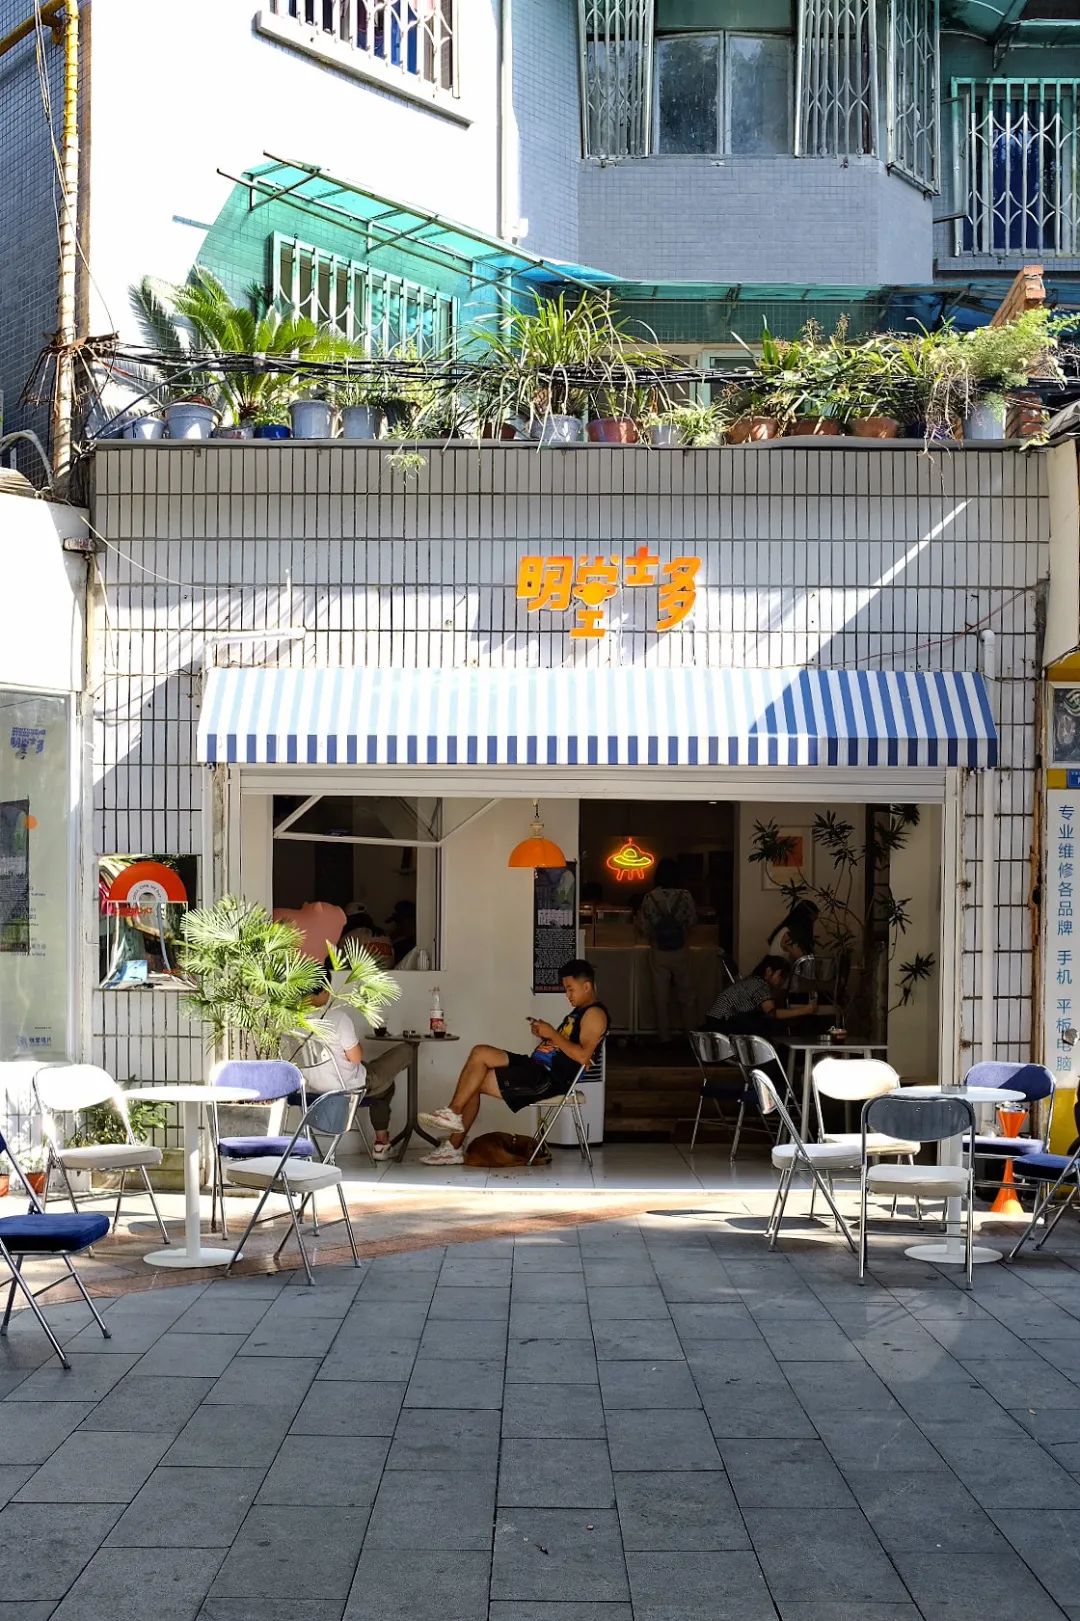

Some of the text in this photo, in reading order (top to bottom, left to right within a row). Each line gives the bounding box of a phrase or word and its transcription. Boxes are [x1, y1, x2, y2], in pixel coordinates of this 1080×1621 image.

[516, 545, 703, 639] 明堂士多
[1058, 804, 1075, 936] 专业维修各品牌
[1056, 949, 1073, 985] 手机
